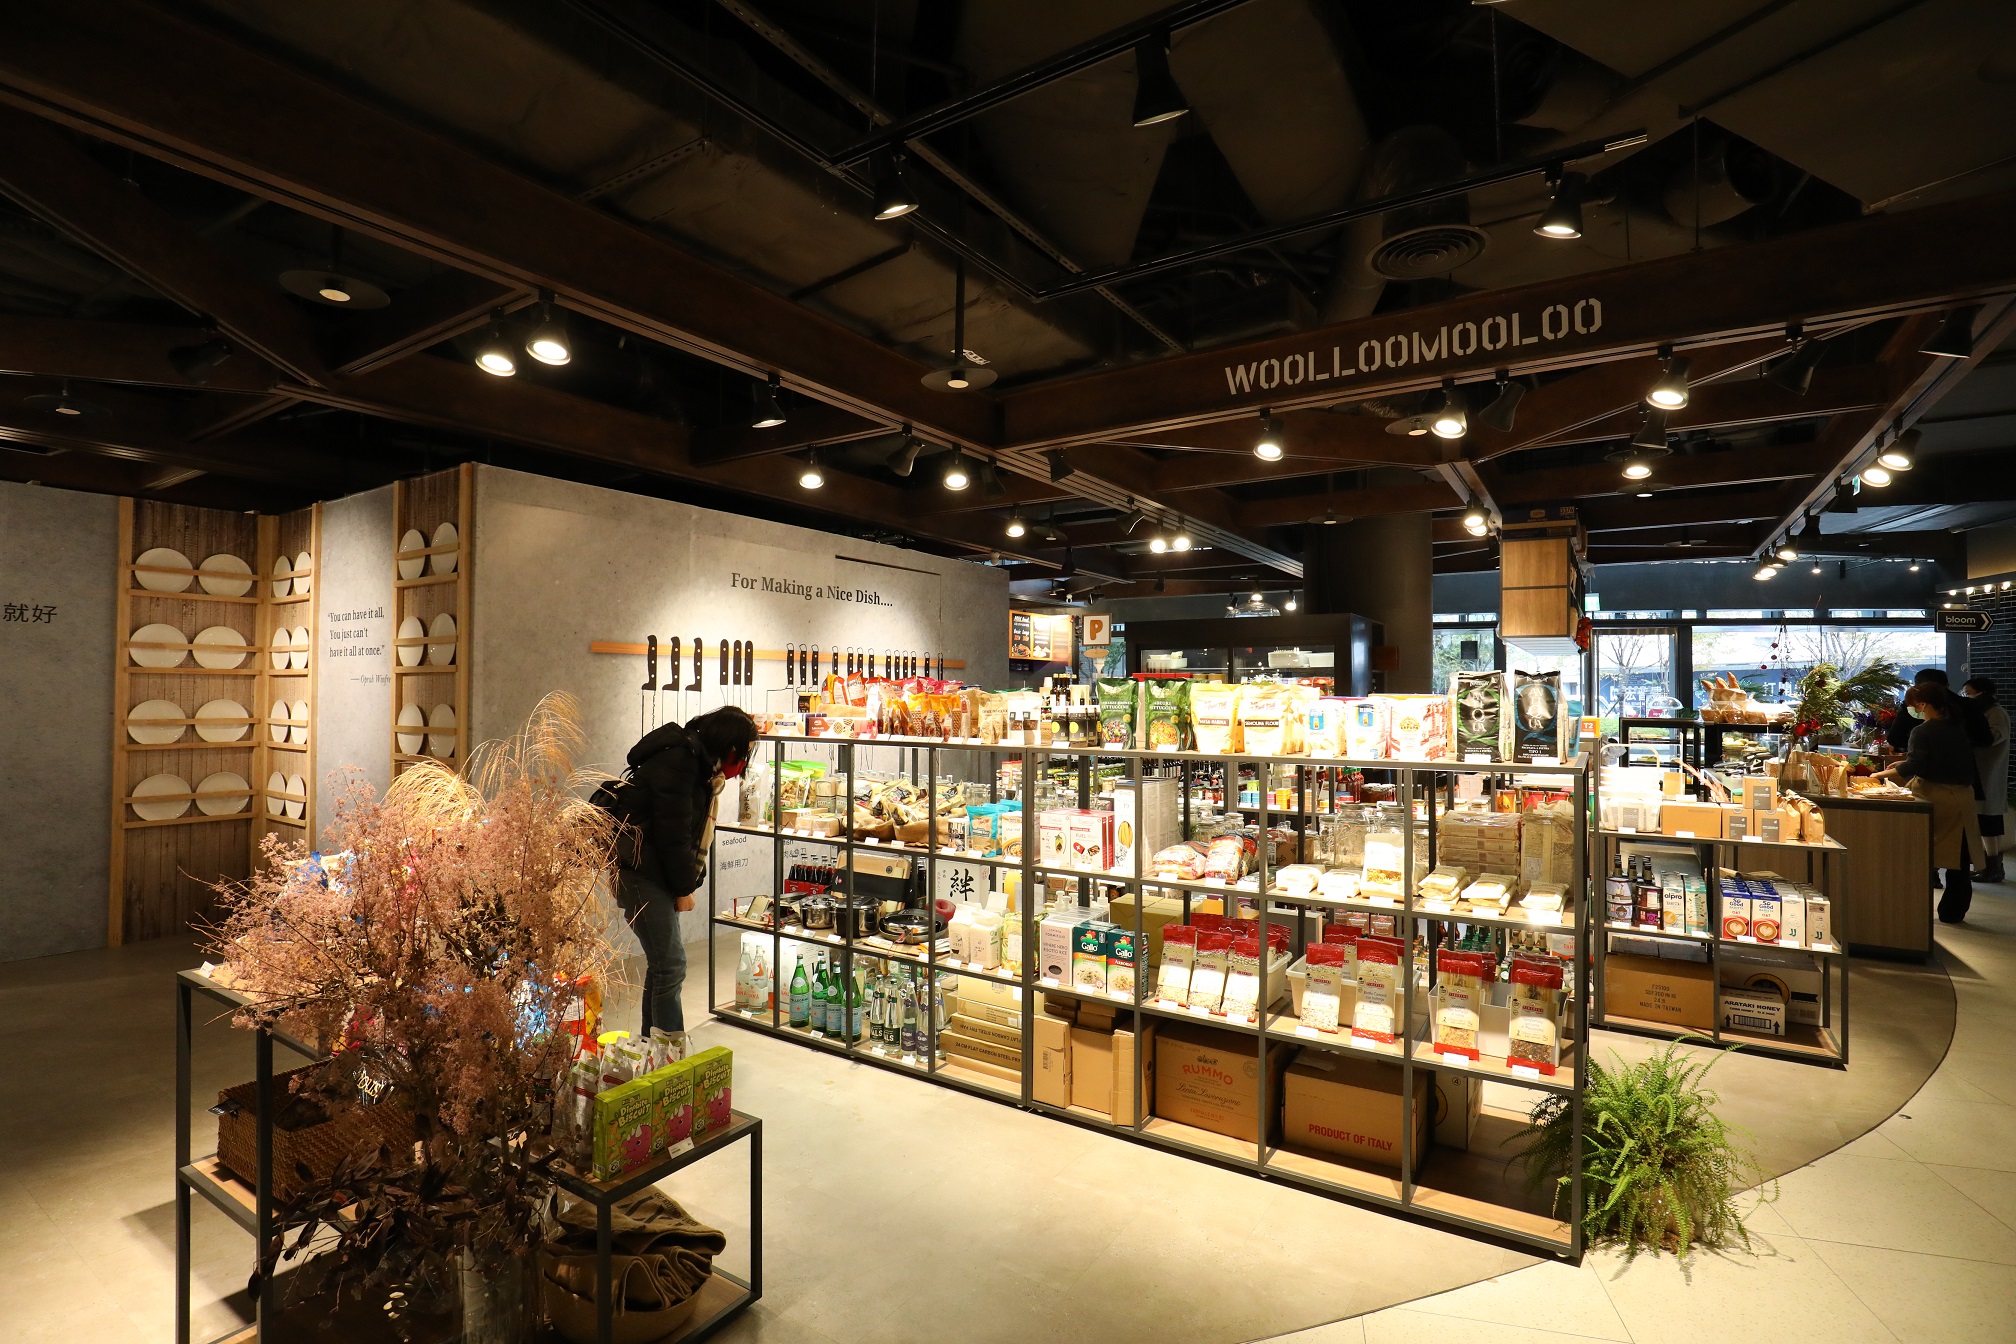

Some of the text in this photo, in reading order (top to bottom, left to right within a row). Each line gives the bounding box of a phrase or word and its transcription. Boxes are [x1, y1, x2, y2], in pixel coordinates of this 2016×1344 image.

[1225, 297, 1602, 395] WOOLLOOMOOLOO
[731, 572, 758, 590] For
[761, 577, 813, 600] Making
[816, 587, 823, 598] a
[827, 585, 853, 602] Nice
[3, 602, 57, 624] 就好
[342, 613, 352, 621] can
[352, 609, 367, 620] have
[368, 607, 374, 619] it
[1945, 615, 1976, 624] bloom
[330, 627, 368, 641] You just can't
[1090, 619, 1104, 641] P
[329, 647, 343, 657] have
[343, 646, 349, 657] it
[349, 645, 357, 657] all
[358, 647, 364, 656] at
[722, 835, 747, 846] seafood
[950, 868, 975, 902] 絆
[1664, 892, 1683, 900] alpro
[1081, 942, 1098, 951] Gallo
[1115, 947, 1133, 958] Gallo
[1639, 1001, 1653, 1009] MADE
[1662, 1004, 1682, 1012] TAIWAN
[1724, 1000, 1755, 1009] ARATAKI
[1756, 1004, 1781, 1012] HONEY
[979, 1048, 998, 1057] CARBON
[1182, 1064, 1234, 1085] RUMMO
[1308, 1123, 1393, 1152] PRODUCT OF ITALY
